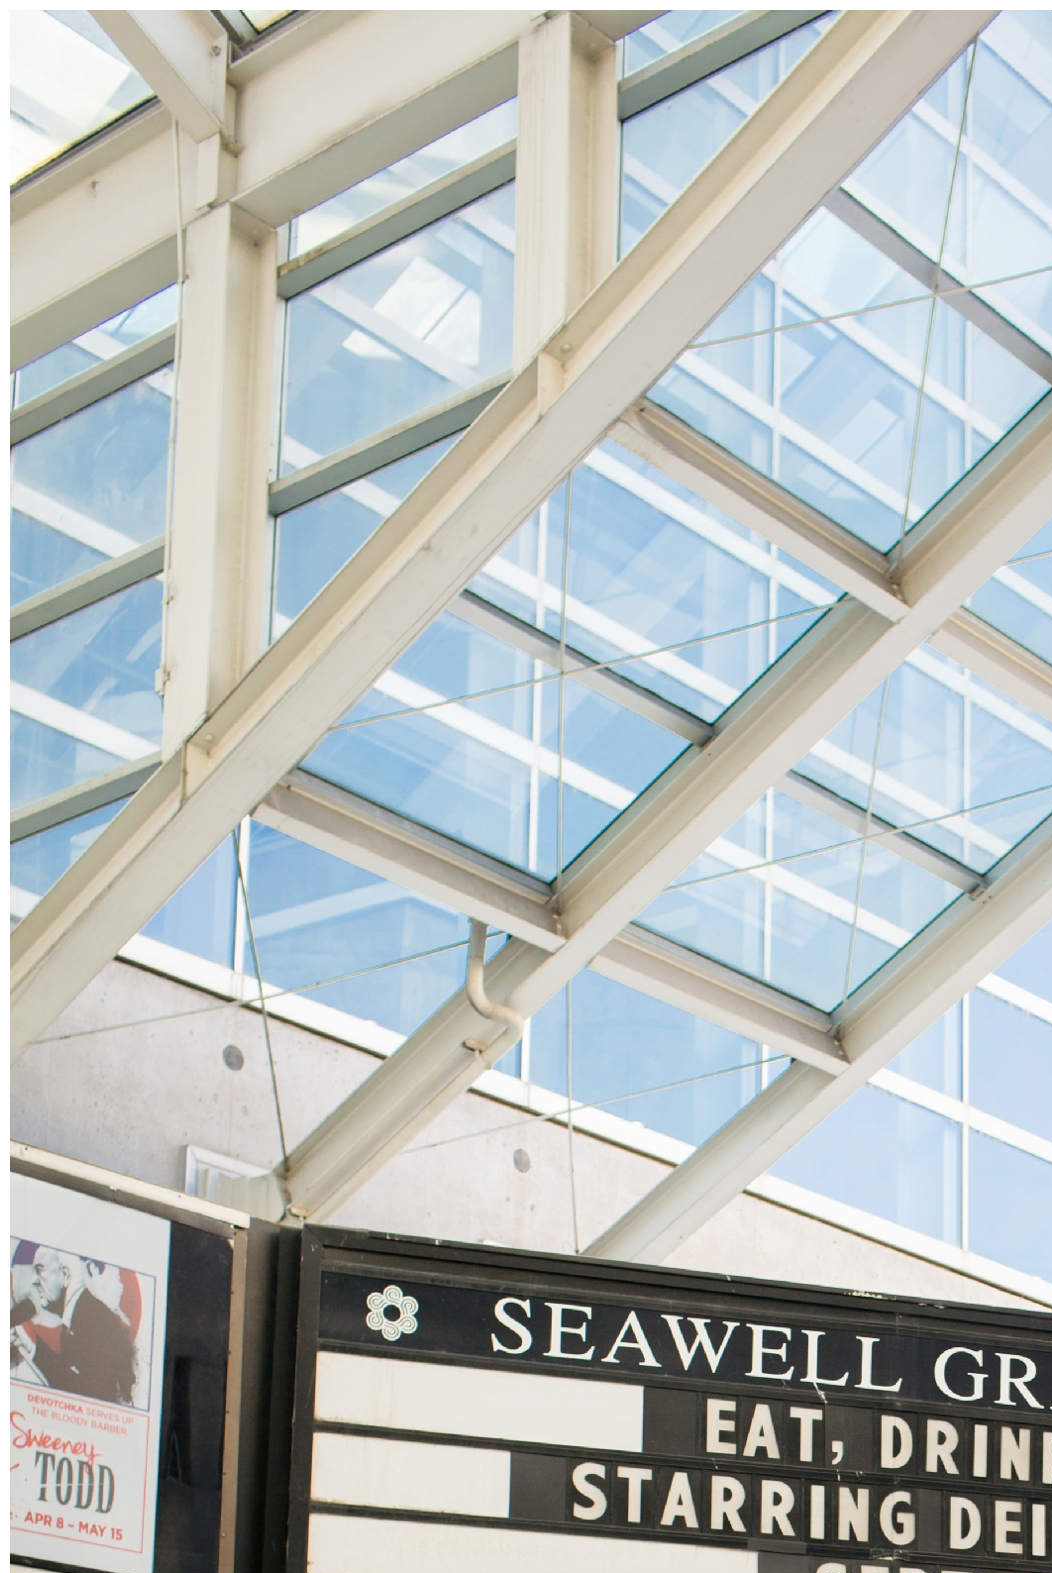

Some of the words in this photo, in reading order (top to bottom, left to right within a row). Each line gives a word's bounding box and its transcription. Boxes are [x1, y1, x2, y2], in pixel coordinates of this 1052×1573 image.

[490, 1296, 903, 1393] SEAWELL
[27, 1393, 83, 1415] DEVOTCHKA
[86, 1407, 120, 1423] SERVES
[121, 1416, 135, 1426] UP
[31, 1406, 49, 1418] THE
[51, 1411, 88, 1426] BLOODY
[706, 1397, 846, 1466] EAT,
[10, 1410, 102, 1475] Sweeney
[35, 1451, 115, 1514] TODD
[571, 1463, 918, 1547] STARRING
[24, 1511, 52, 1527] APR
[56, 1517, 65, 1529] 8
[78, 1520, 107, 1538] MAY
[110, 1527, 124, 1541] 15
